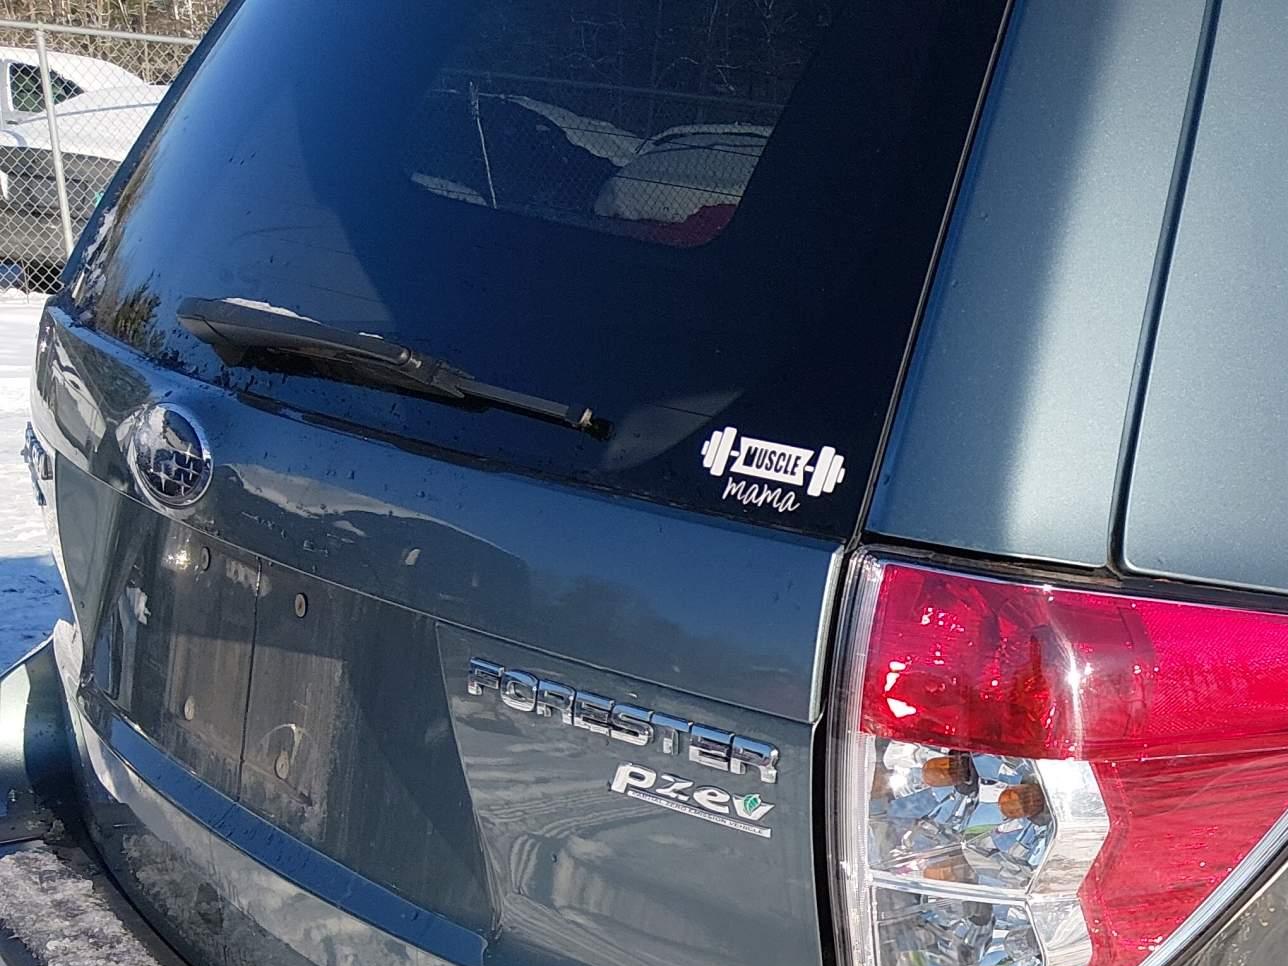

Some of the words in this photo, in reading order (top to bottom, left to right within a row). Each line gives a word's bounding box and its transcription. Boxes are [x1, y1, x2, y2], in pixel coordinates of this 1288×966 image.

[742, 446, 802, 476] MUSCLE
[722, 477, 800, 513] mama
[467, 656, 780, 784] FORESTER
